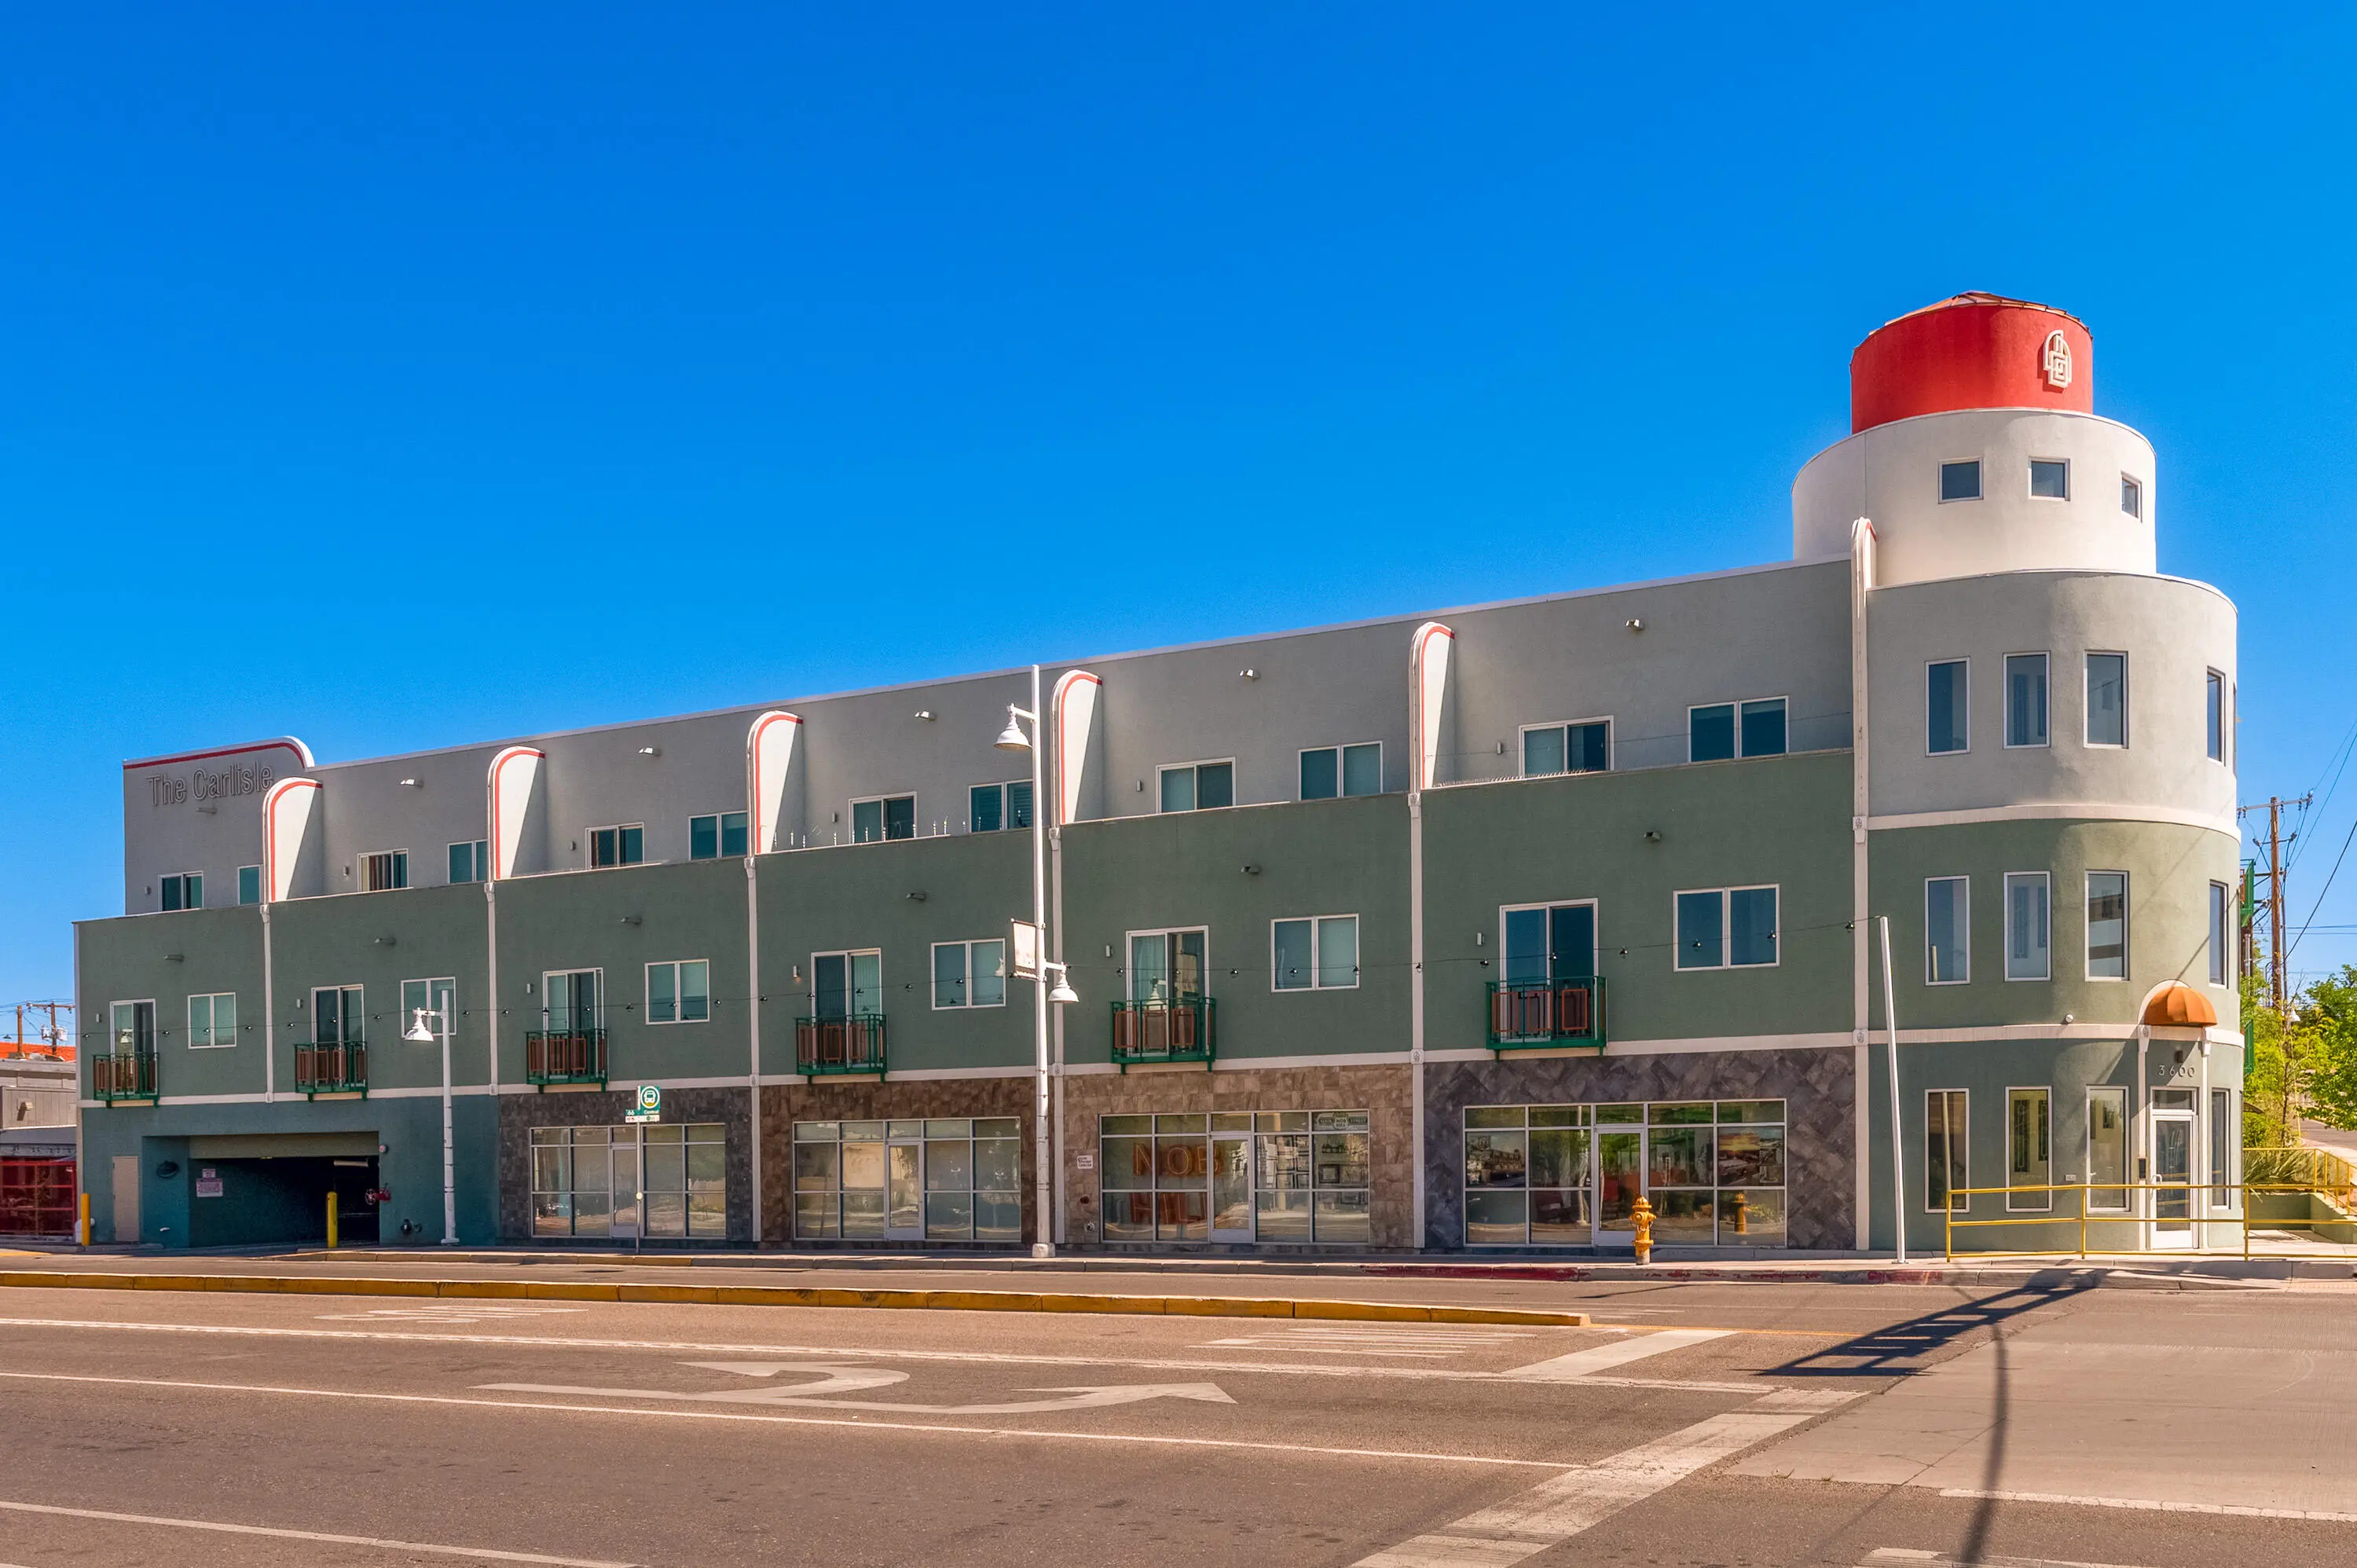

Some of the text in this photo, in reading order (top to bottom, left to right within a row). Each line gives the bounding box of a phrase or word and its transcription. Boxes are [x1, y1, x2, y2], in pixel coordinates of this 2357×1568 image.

[147, 760, 274, 807] The Carlisle
[2158, 1064, 2195, 1077] 3600
[1133, 1143, 1223, 1176] NOB
